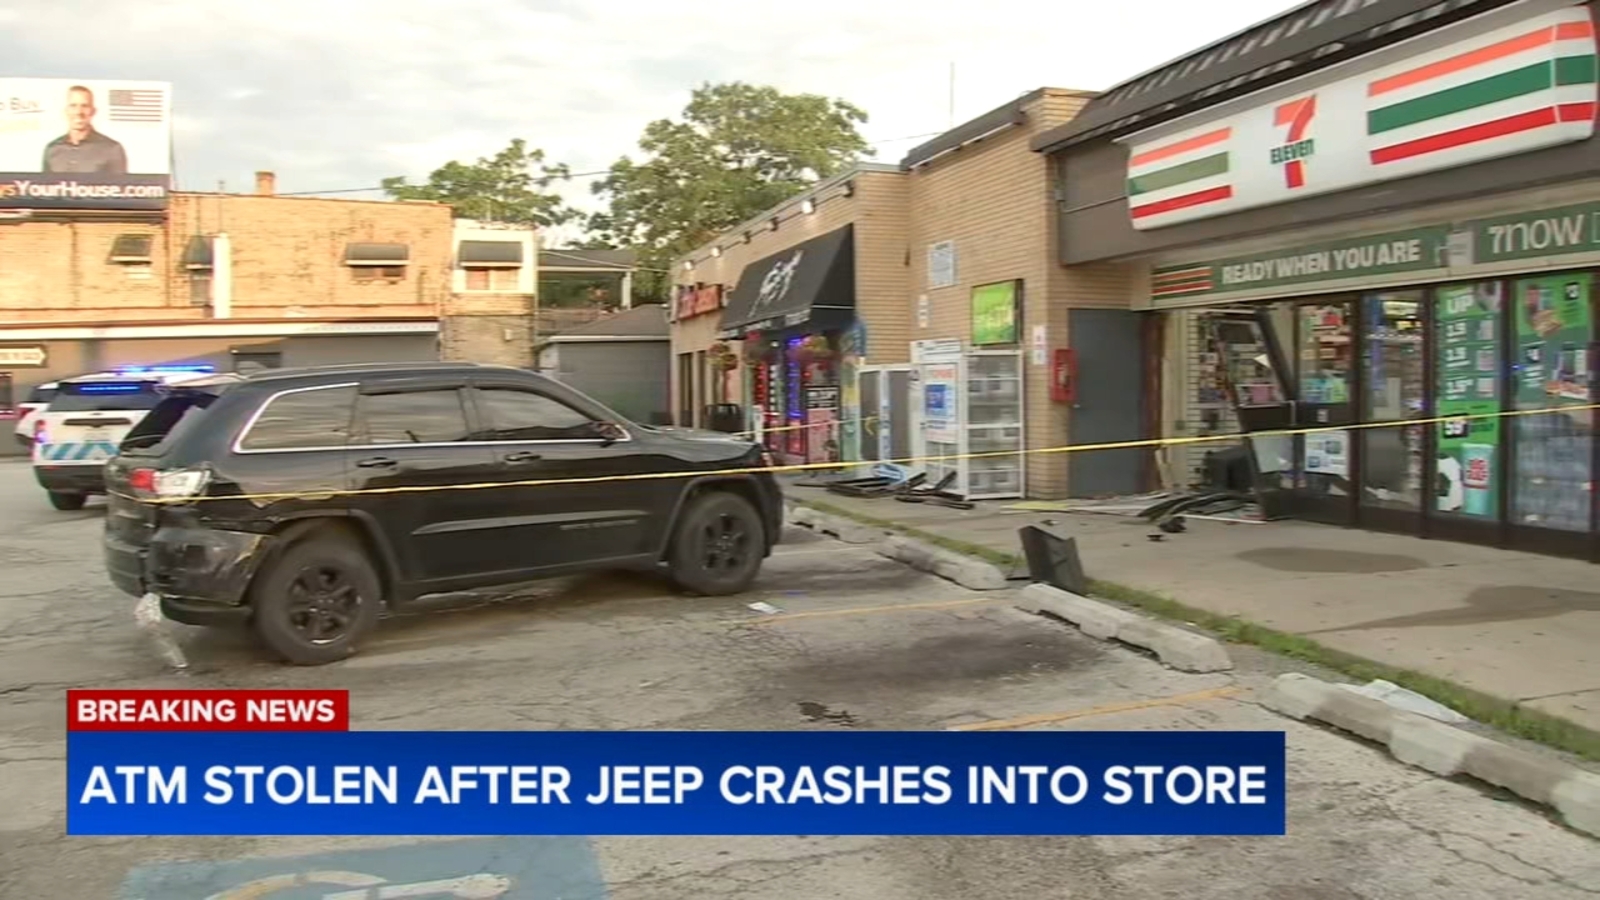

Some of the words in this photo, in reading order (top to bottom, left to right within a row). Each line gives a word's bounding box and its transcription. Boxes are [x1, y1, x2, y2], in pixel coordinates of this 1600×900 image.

[1274, 95, 1316, 189] 7
[1222, 259, 1274, 284] READY
[1275, 252, 1330, 278] WHEN
[1332, 246, 1375, 271] YOU
[1376, 239, 1421, 266] ARE
